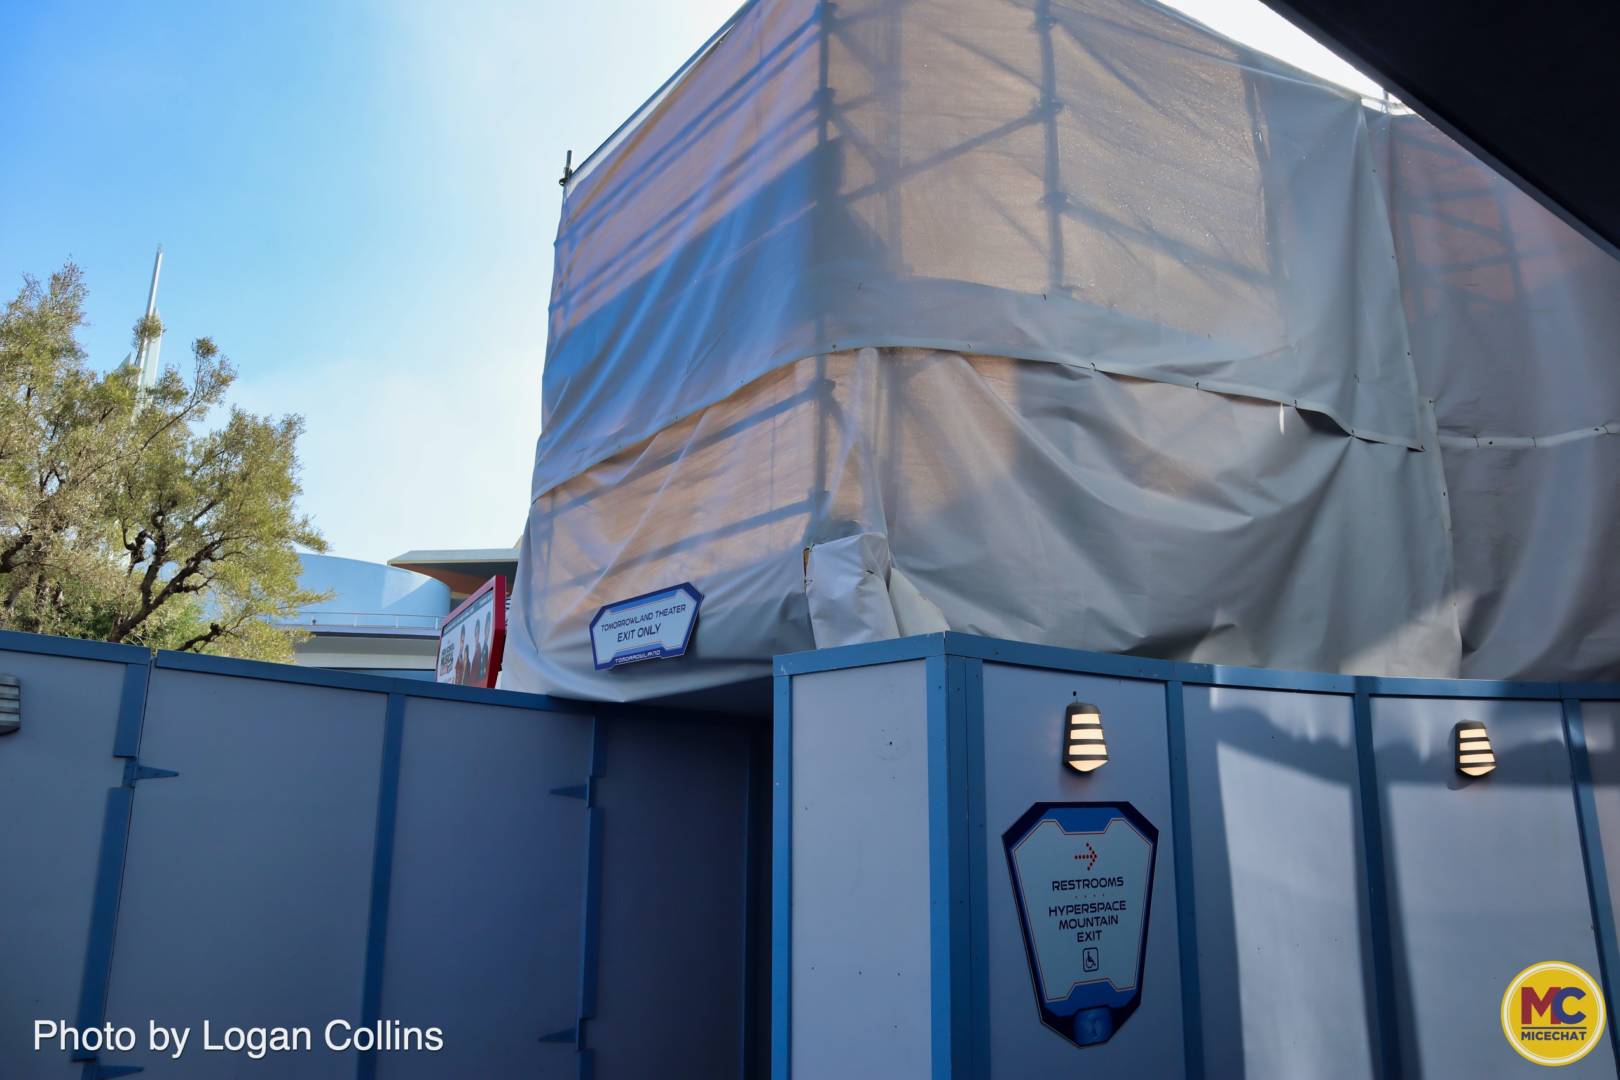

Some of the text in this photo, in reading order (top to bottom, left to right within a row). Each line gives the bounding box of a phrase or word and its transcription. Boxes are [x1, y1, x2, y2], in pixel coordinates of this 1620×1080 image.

[601, 604, 687, 632] TOMORROWLAND THEATER
[617, 623, 661, 643] EXIT ONLY
[1052, 876, 1124, 891] RESTROOMS
[1049, 900, 1127, 917] HYPERSPACE
[1058, 915, 1119, 930] MOUNTAIN
[1077, 930, 1102, 943] EXIT
